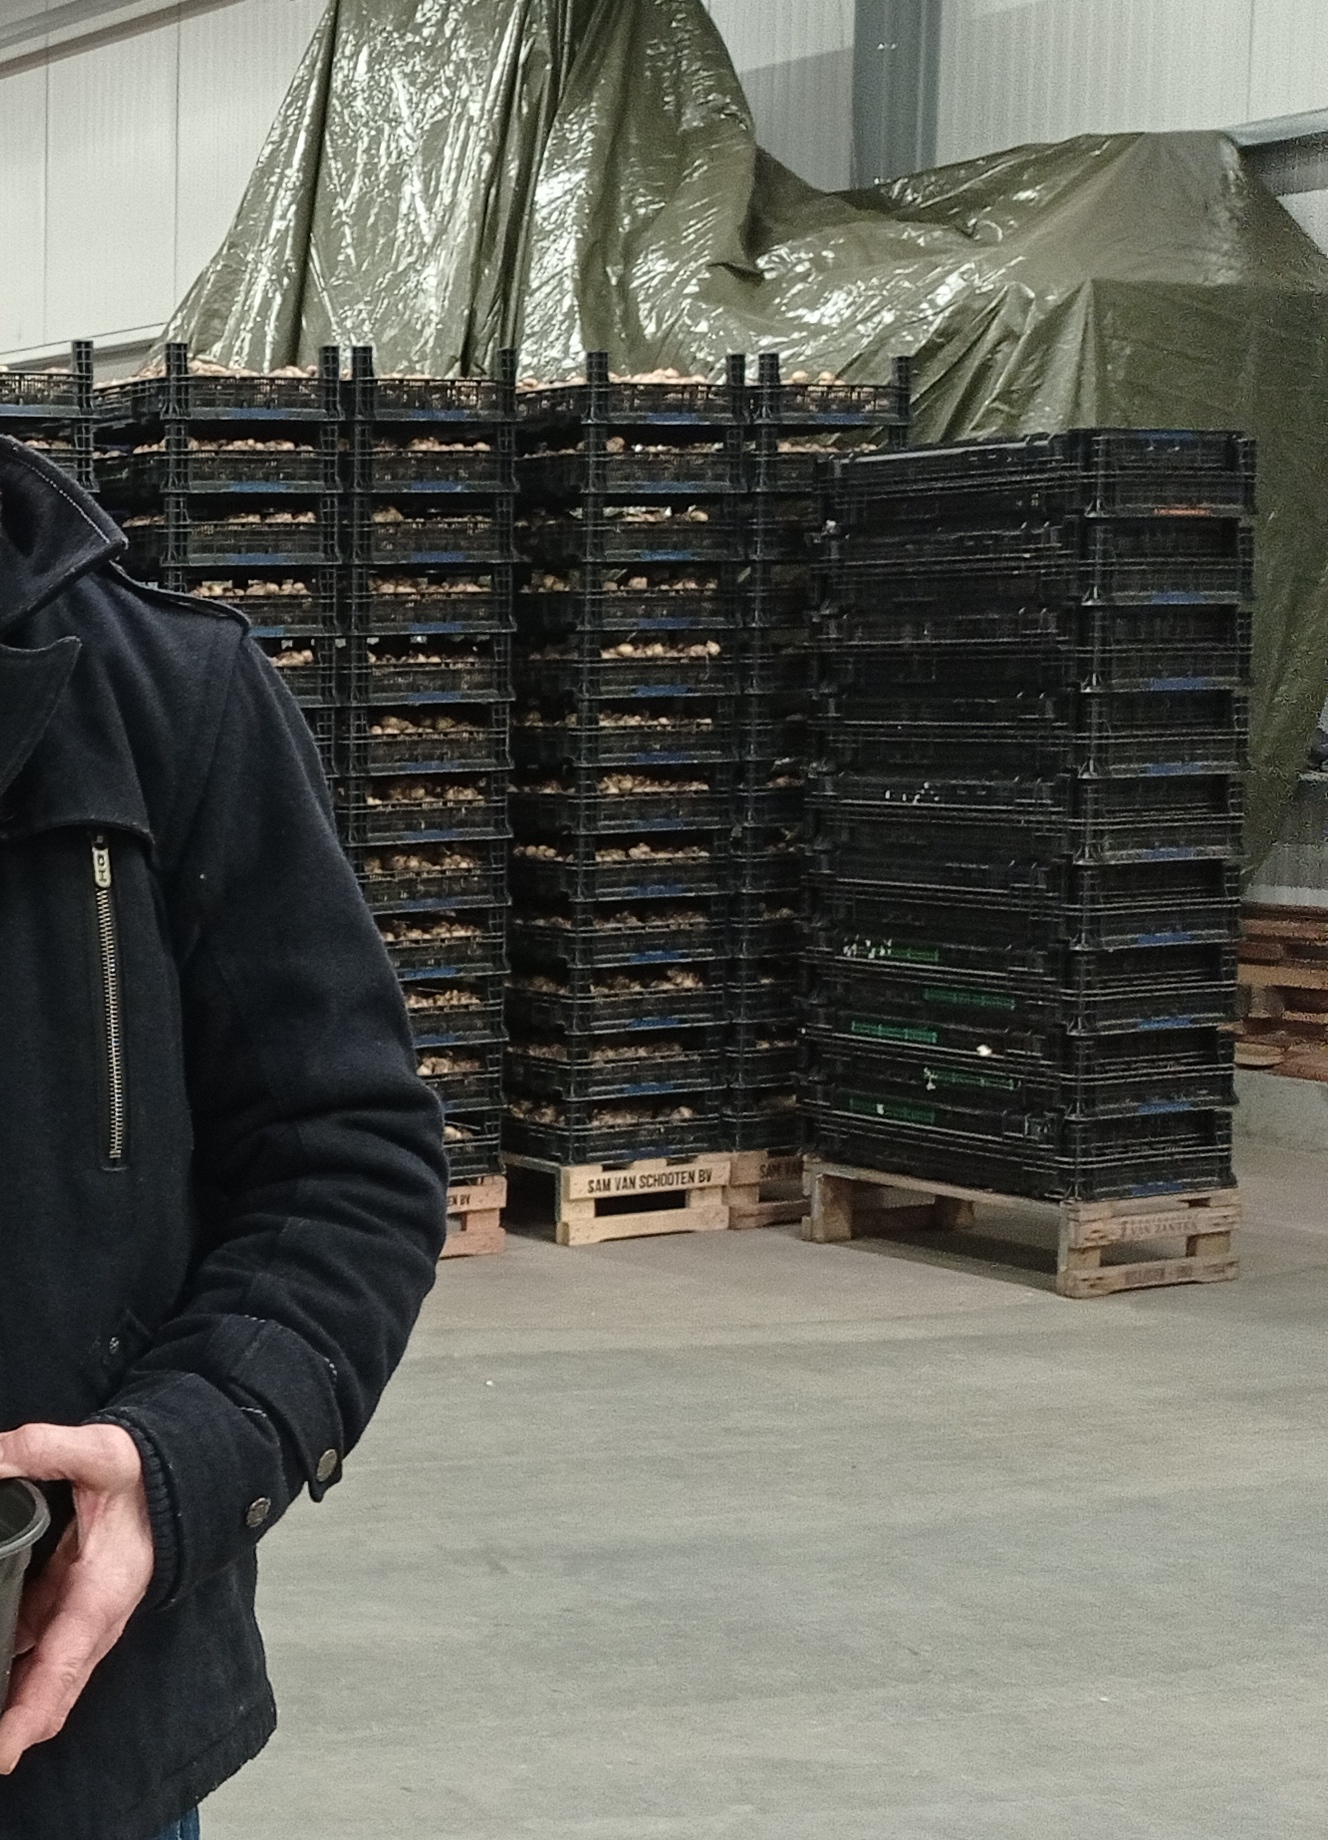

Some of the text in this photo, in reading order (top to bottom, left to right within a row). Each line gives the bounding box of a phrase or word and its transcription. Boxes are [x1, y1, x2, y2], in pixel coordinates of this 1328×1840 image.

[588, 1167, 712, 1193] SAM VAN SCHOOTEN BV
